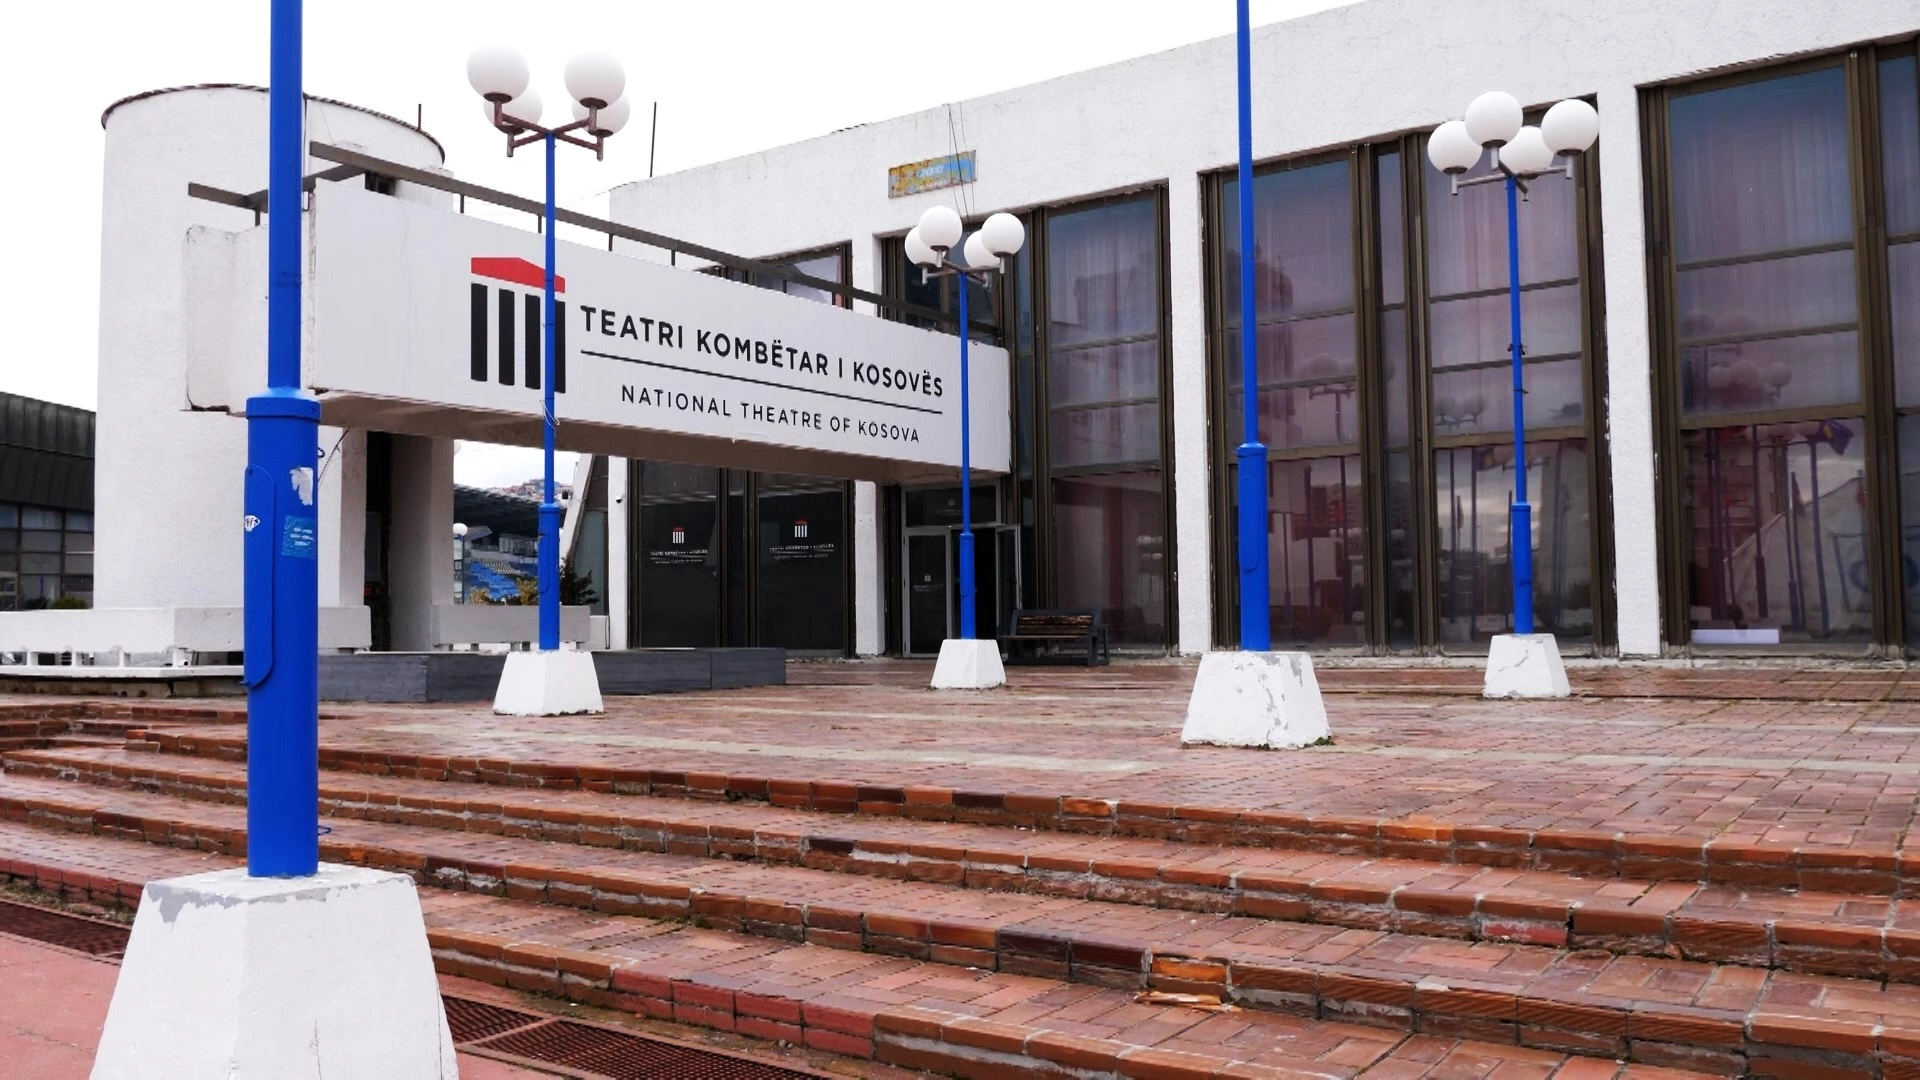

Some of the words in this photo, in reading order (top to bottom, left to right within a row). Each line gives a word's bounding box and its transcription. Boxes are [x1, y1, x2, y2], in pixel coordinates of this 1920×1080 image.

[580, 305, 683, 350] TEATRI
[696, 329, 829, 376] KOMBËTAR
[838, 357, 843, 378] I
[853, 361, 943, 398] KOSOVËS
[621, 385, 732, 417] NATIONAL
[740, 402, 820, 430] THEATRE
[829, 415, 851, 433] OF
[858, 419, 919, 442] KOSOVA
